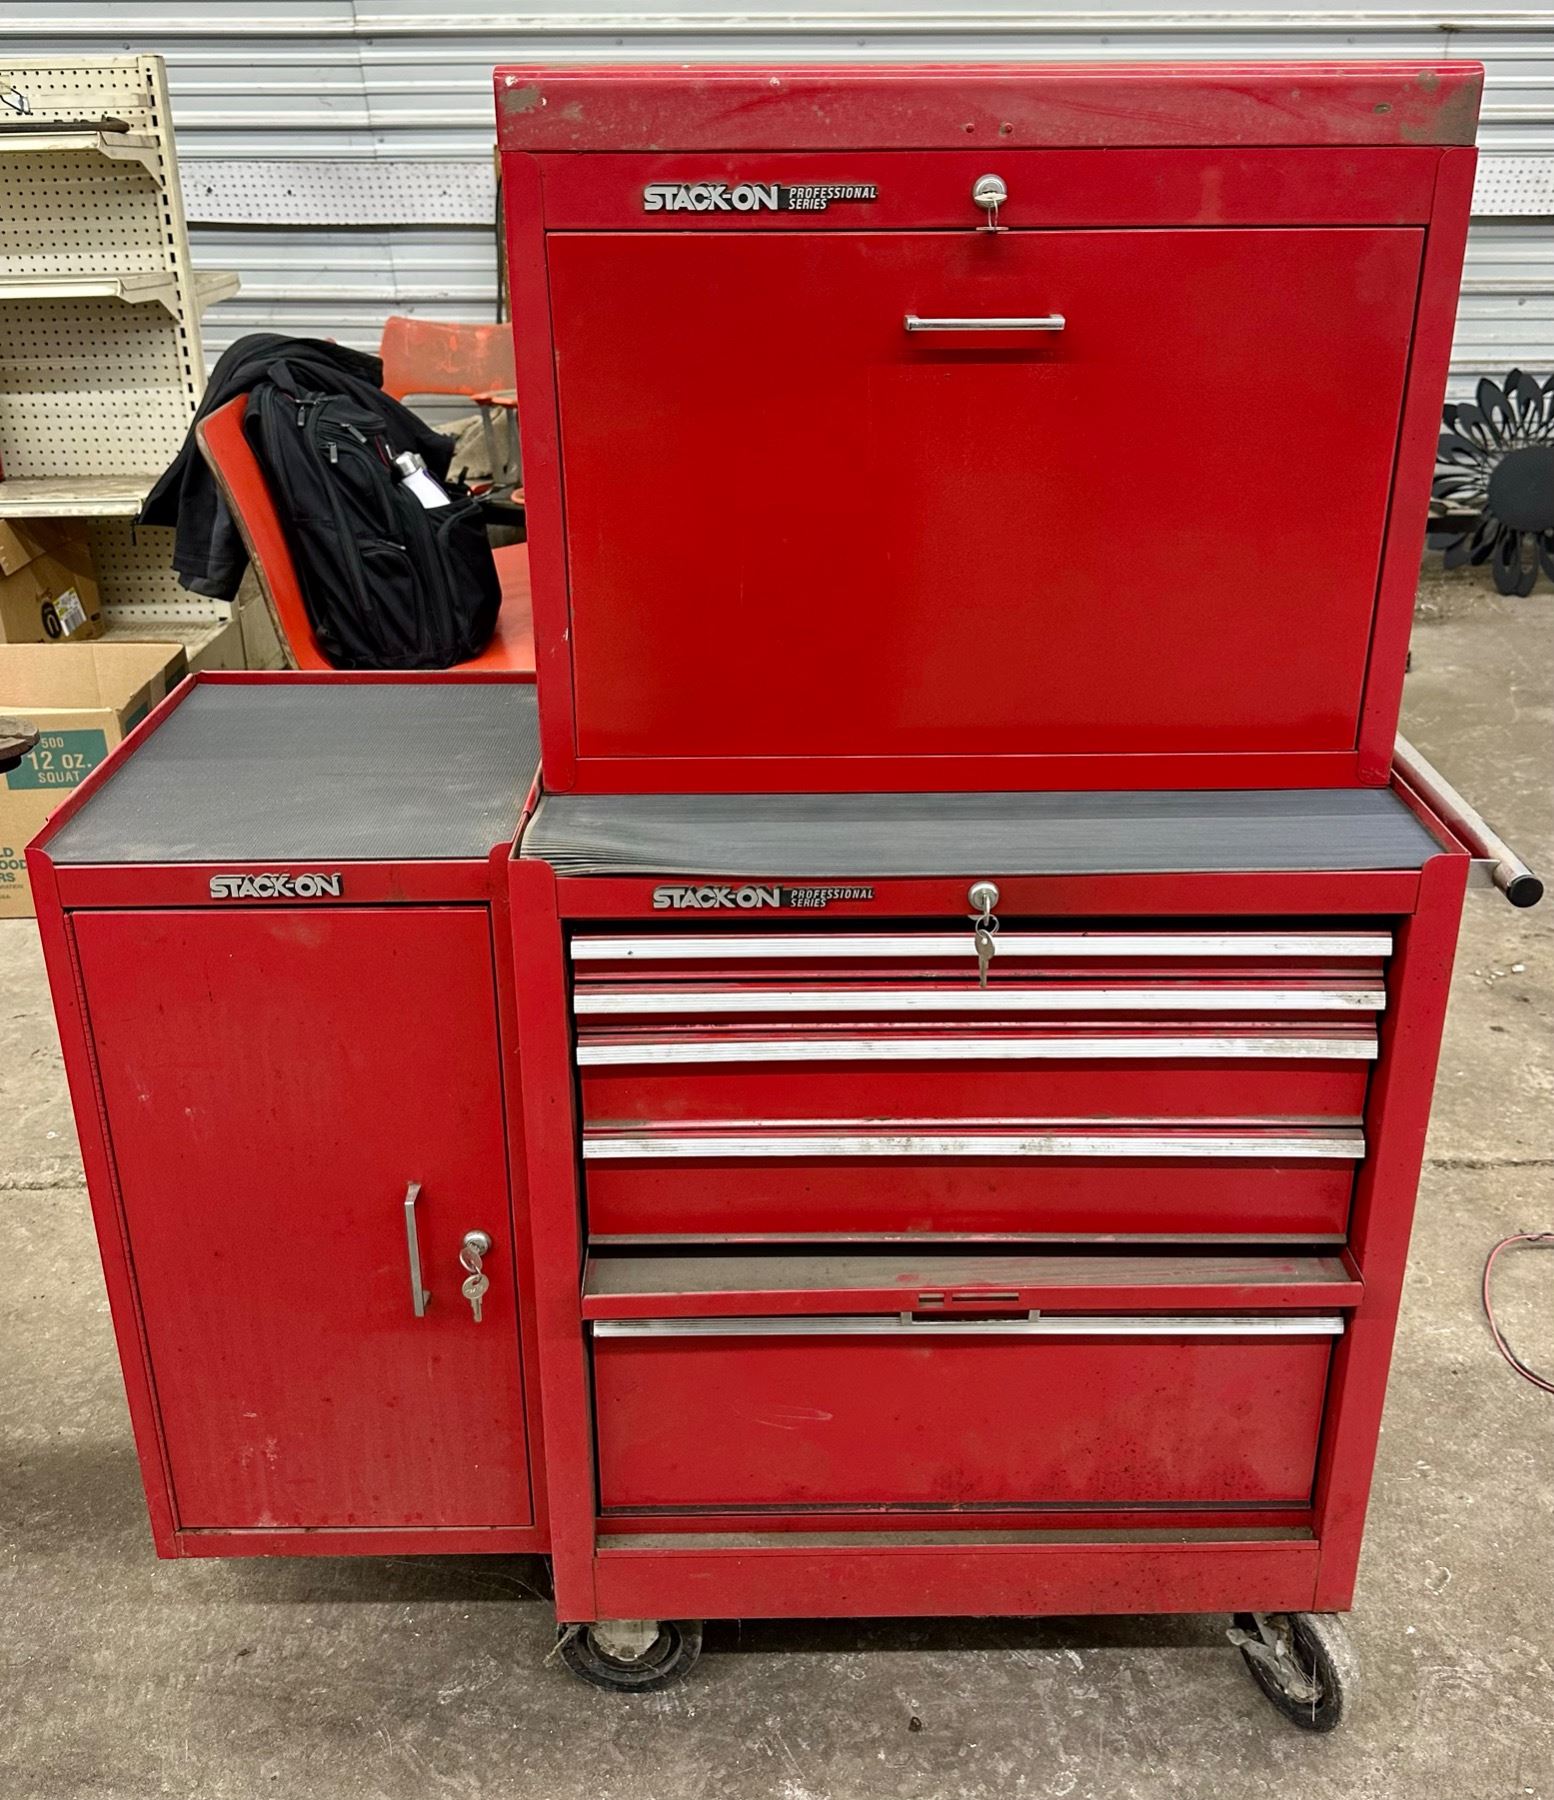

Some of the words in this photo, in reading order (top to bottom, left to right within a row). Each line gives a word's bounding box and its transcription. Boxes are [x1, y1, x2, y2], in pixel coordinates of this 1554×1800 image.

[644, 184, 778, 211] STACK-ON
[789, 186, 877, 199] PROFESSIONAL
[788, 198, 828, 210] SERIES
[41, 736, 64, 749] 500
[27, 750, 55, 770] 12
[61, 753, 92, 769] OZ.
[38, 770, 80, 783] SQUAT
[210, 873, 341, 898] STACK-ON
[653, 885, 782, 909] STACK-ON
[790, 888, 874, 900] PROFESSIONAL
[790, 898, 827, 908] SERIES
